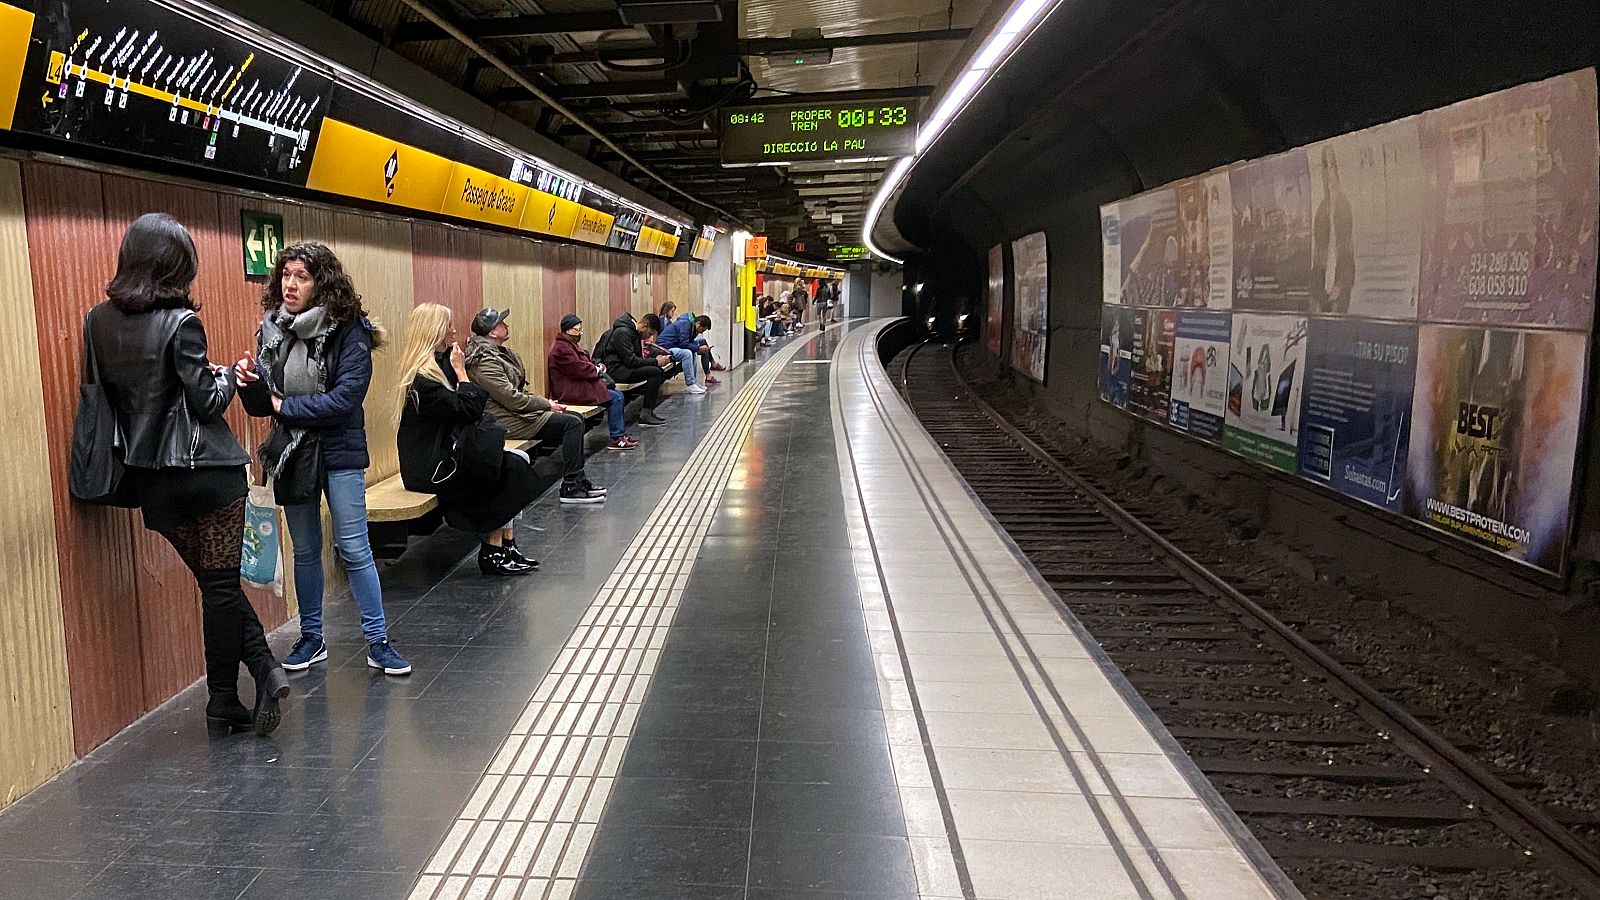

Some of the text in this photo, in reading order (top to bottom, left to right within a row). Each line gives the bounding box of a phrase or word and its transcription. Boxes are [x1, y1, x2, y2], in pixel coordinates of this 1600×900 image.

[48, 62, 61, 81] L4
[730, 113, 765, 124] 08:42
[790, 109, 832, 121] PROPER
[837, 106, 907, 128] 00:33
[791, 121, 818, 131] TREN
[823, 141, 838, 151] LA
[844, 139, 865, 150] PAU
[461, 177, 489, 212] Passeig
[487, 186, 498, 209] de
[1469, 275, 1528, 296] 608 058 910
[1457, 402, 1500, 440] BEST
[1427, 498, 1530, 544] WWW.BESTPROTEIN.COM
